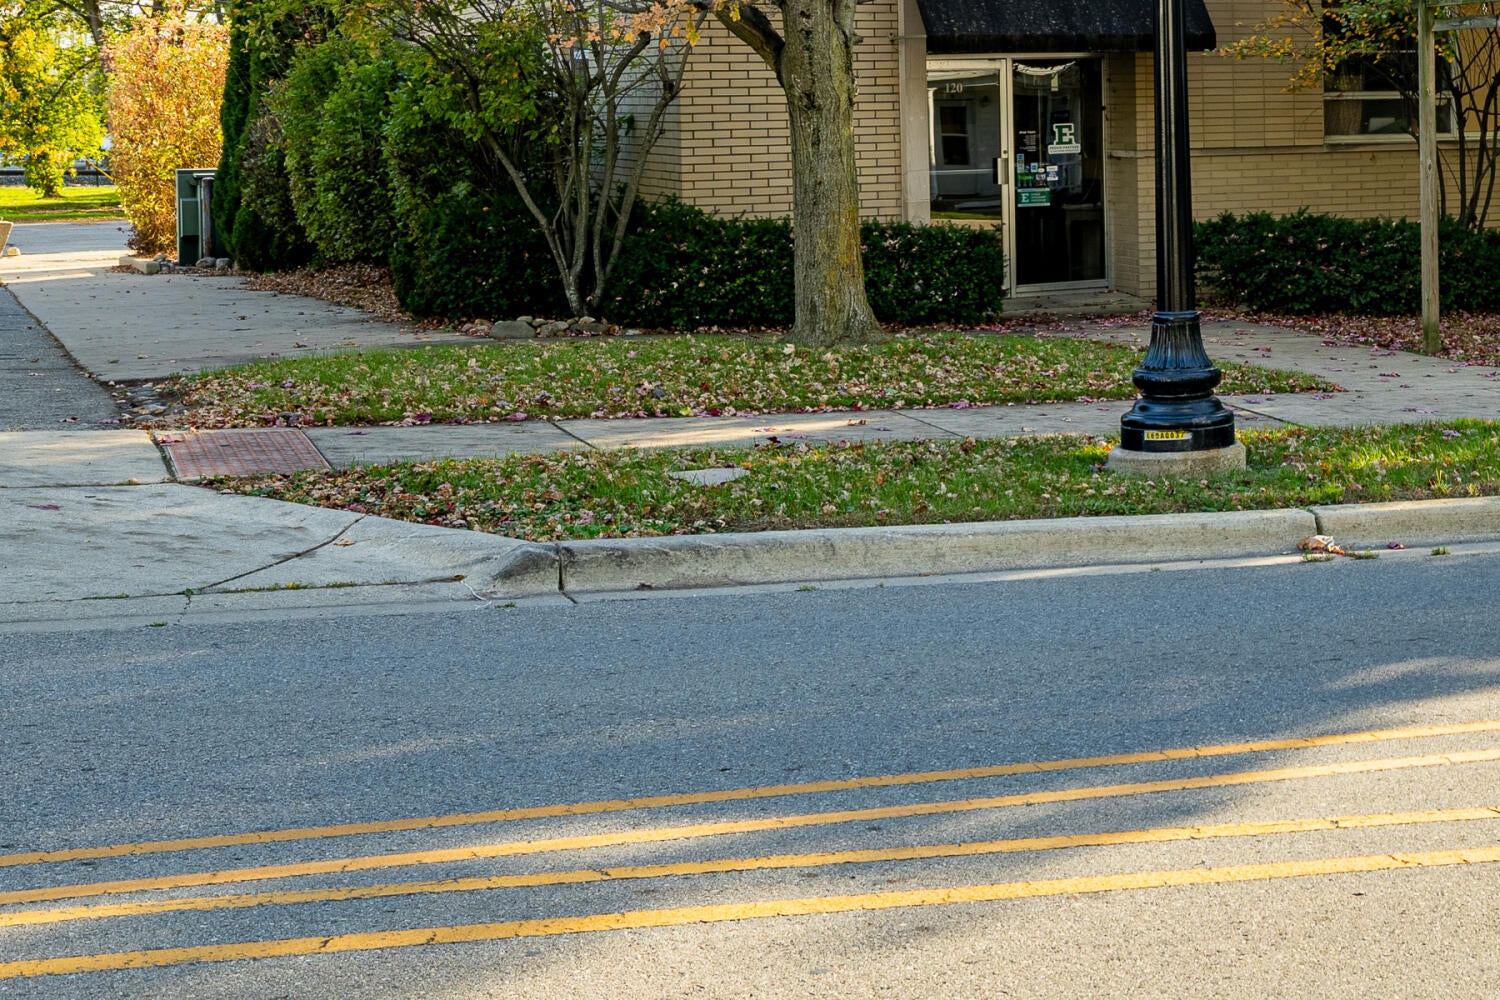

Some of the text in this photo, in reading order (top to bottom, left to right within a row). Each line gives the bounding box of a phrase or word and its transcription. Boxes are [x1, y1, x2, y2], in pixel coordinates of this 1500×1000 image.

[945, 82, 963, 93] 120
[1055, 125, 1073, 145] E
[1021, 193, 1030, 203] E
